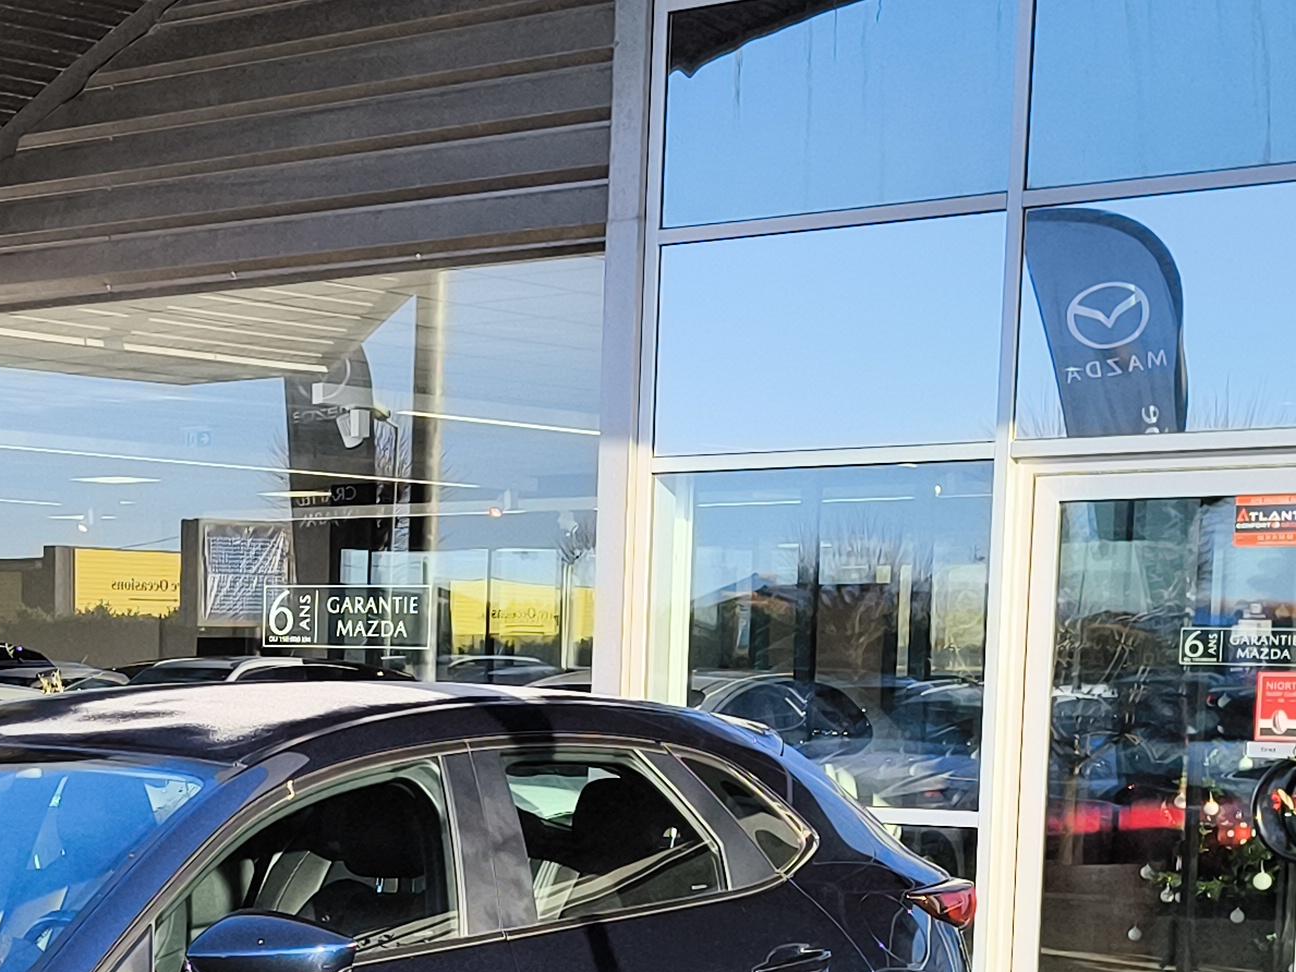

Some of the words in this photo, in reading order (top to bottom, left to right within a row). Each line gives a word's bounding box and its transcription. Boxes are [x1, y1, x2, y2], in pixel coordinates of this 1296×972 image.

[269, 590, 294, 636] 6
[299, 594, 311, 631] ANS
[327, 596, 418, 614] GARANTIE
[336, 620, 407, 638] MAZDA
[1184, 631, 1204, 658] 6
[1208, 634, 1217, 655] ANS
[1236, 648, 1291, 660] MAZDA
